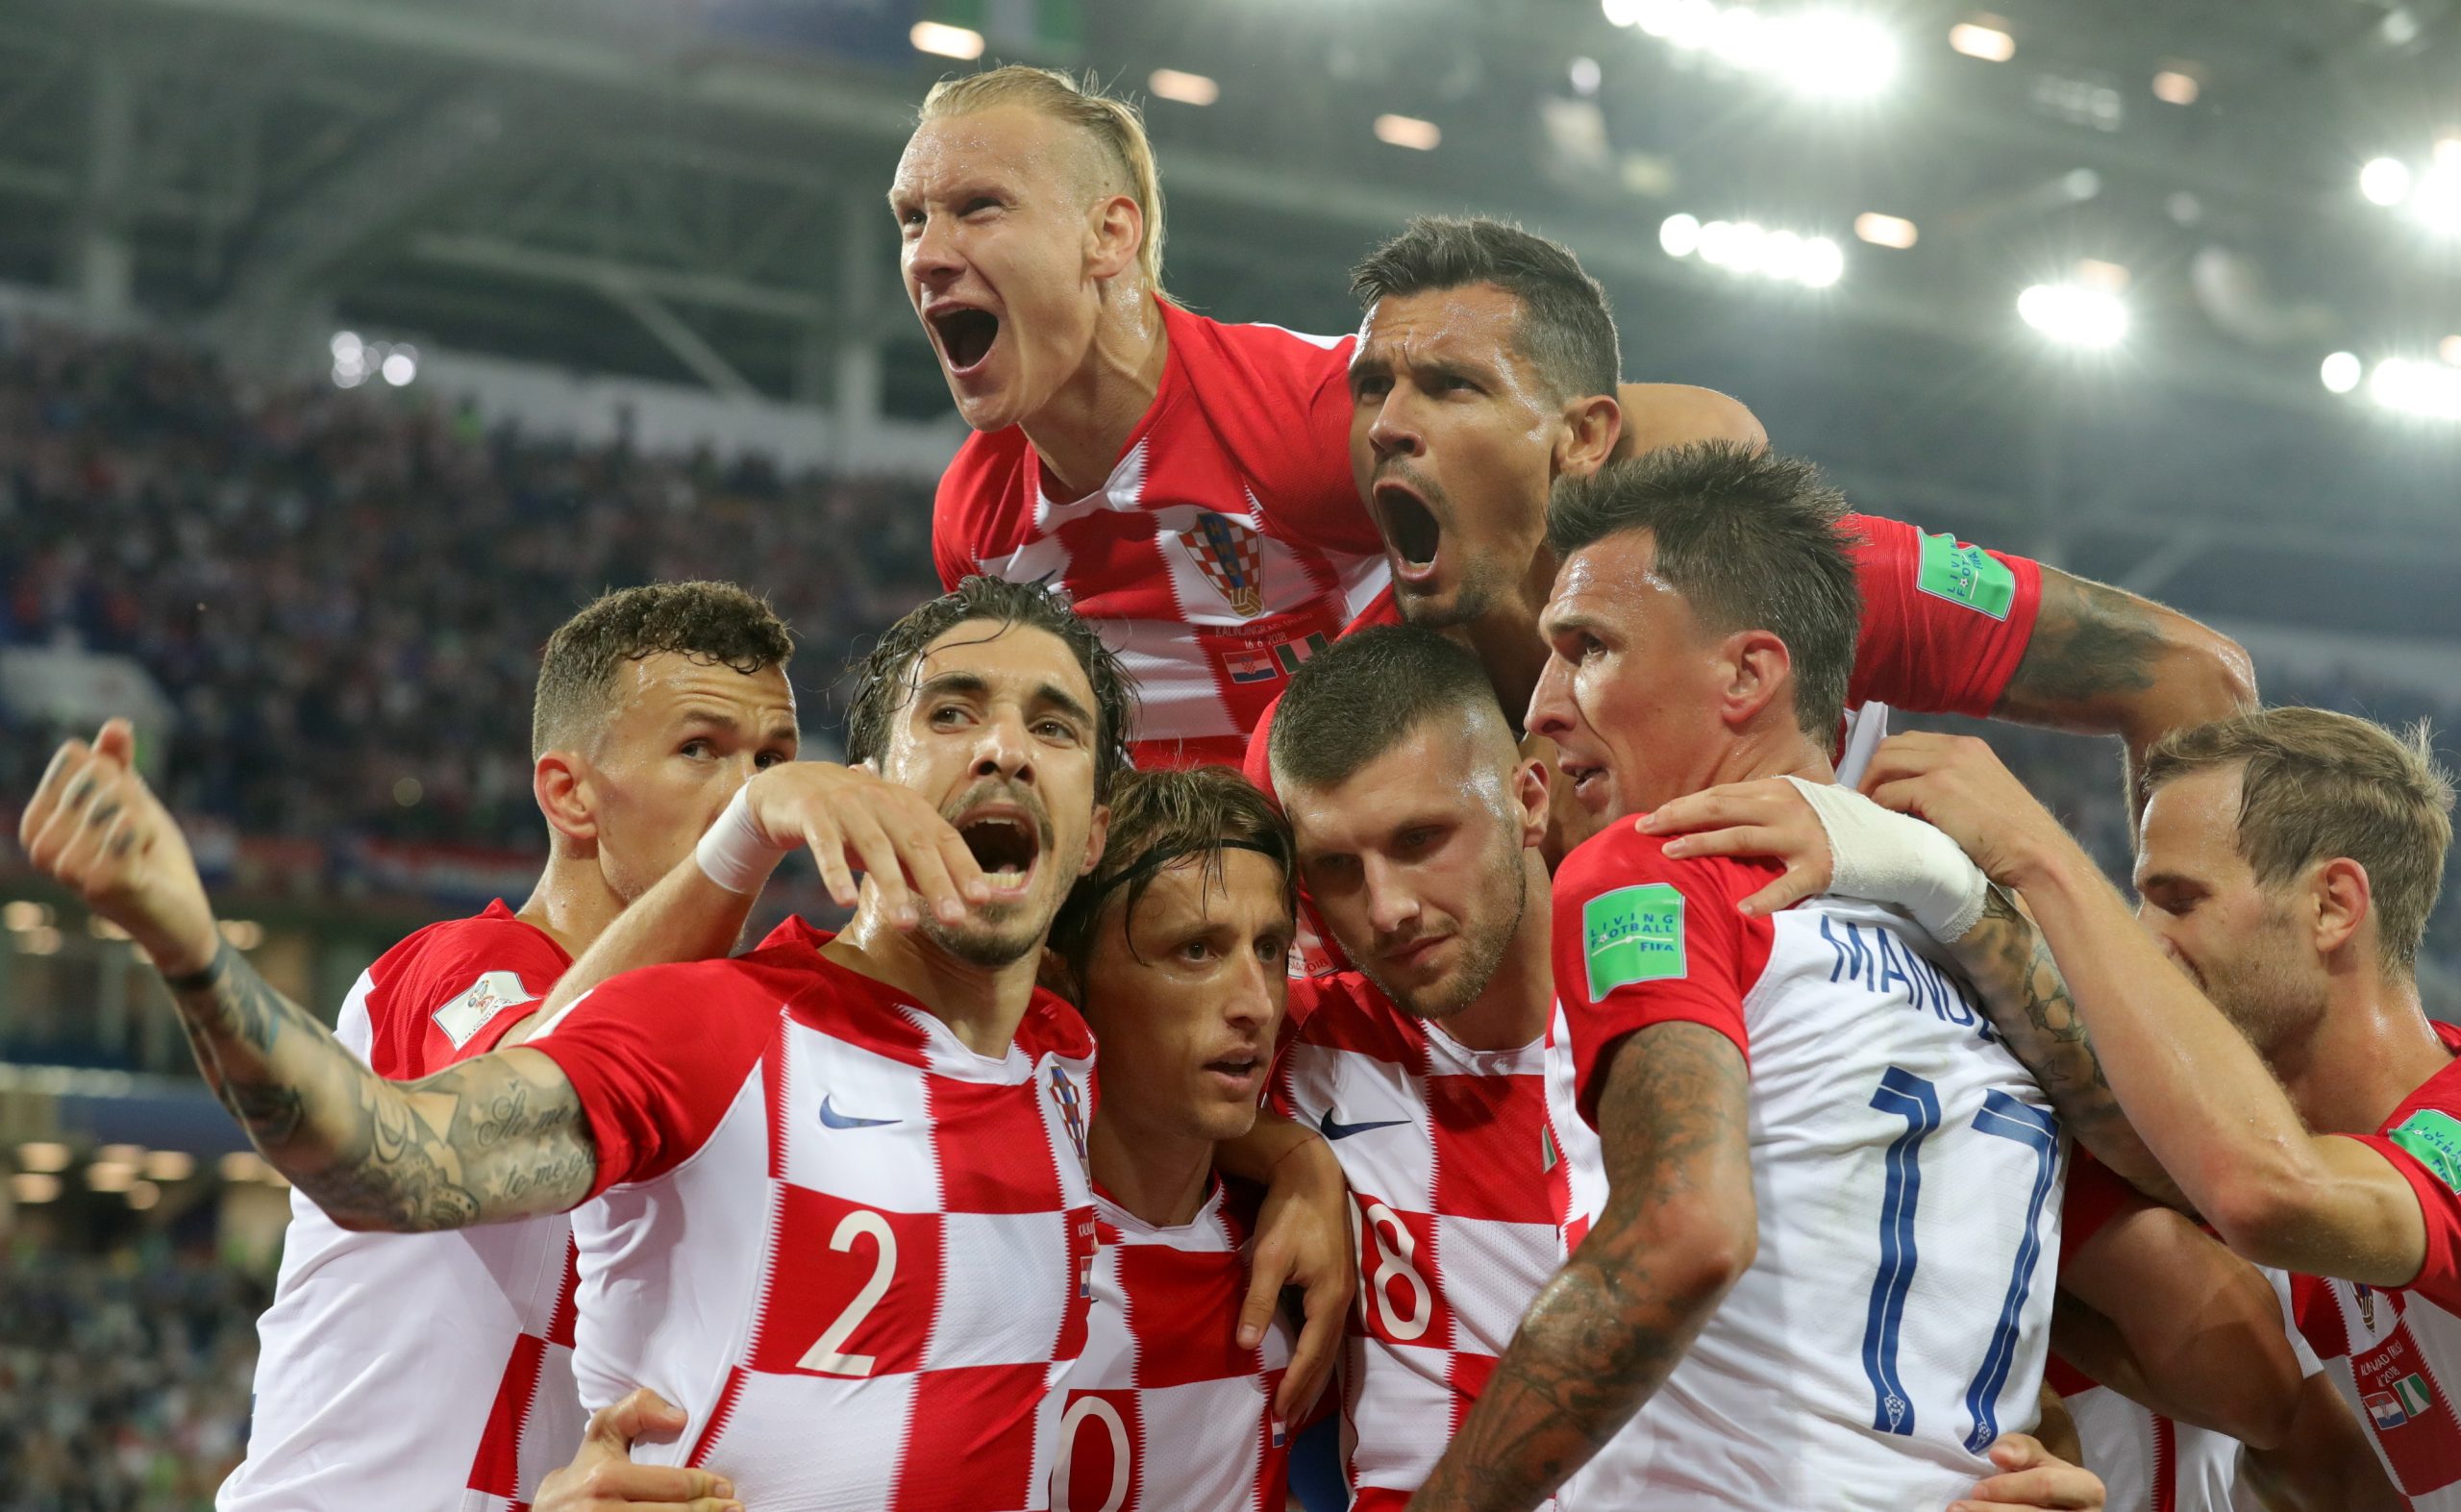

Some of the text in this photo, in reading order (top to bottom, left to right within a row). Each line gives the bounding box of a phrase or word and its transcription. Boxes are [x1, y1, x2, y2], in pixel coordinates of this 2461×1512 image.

[1590, 912, 1674, 938] LIVING
[1640, 941, 1675, 953] FIFA
[794, 1209, 898, 1377] 2
[1861, 1064, 2060, 1455] 17
